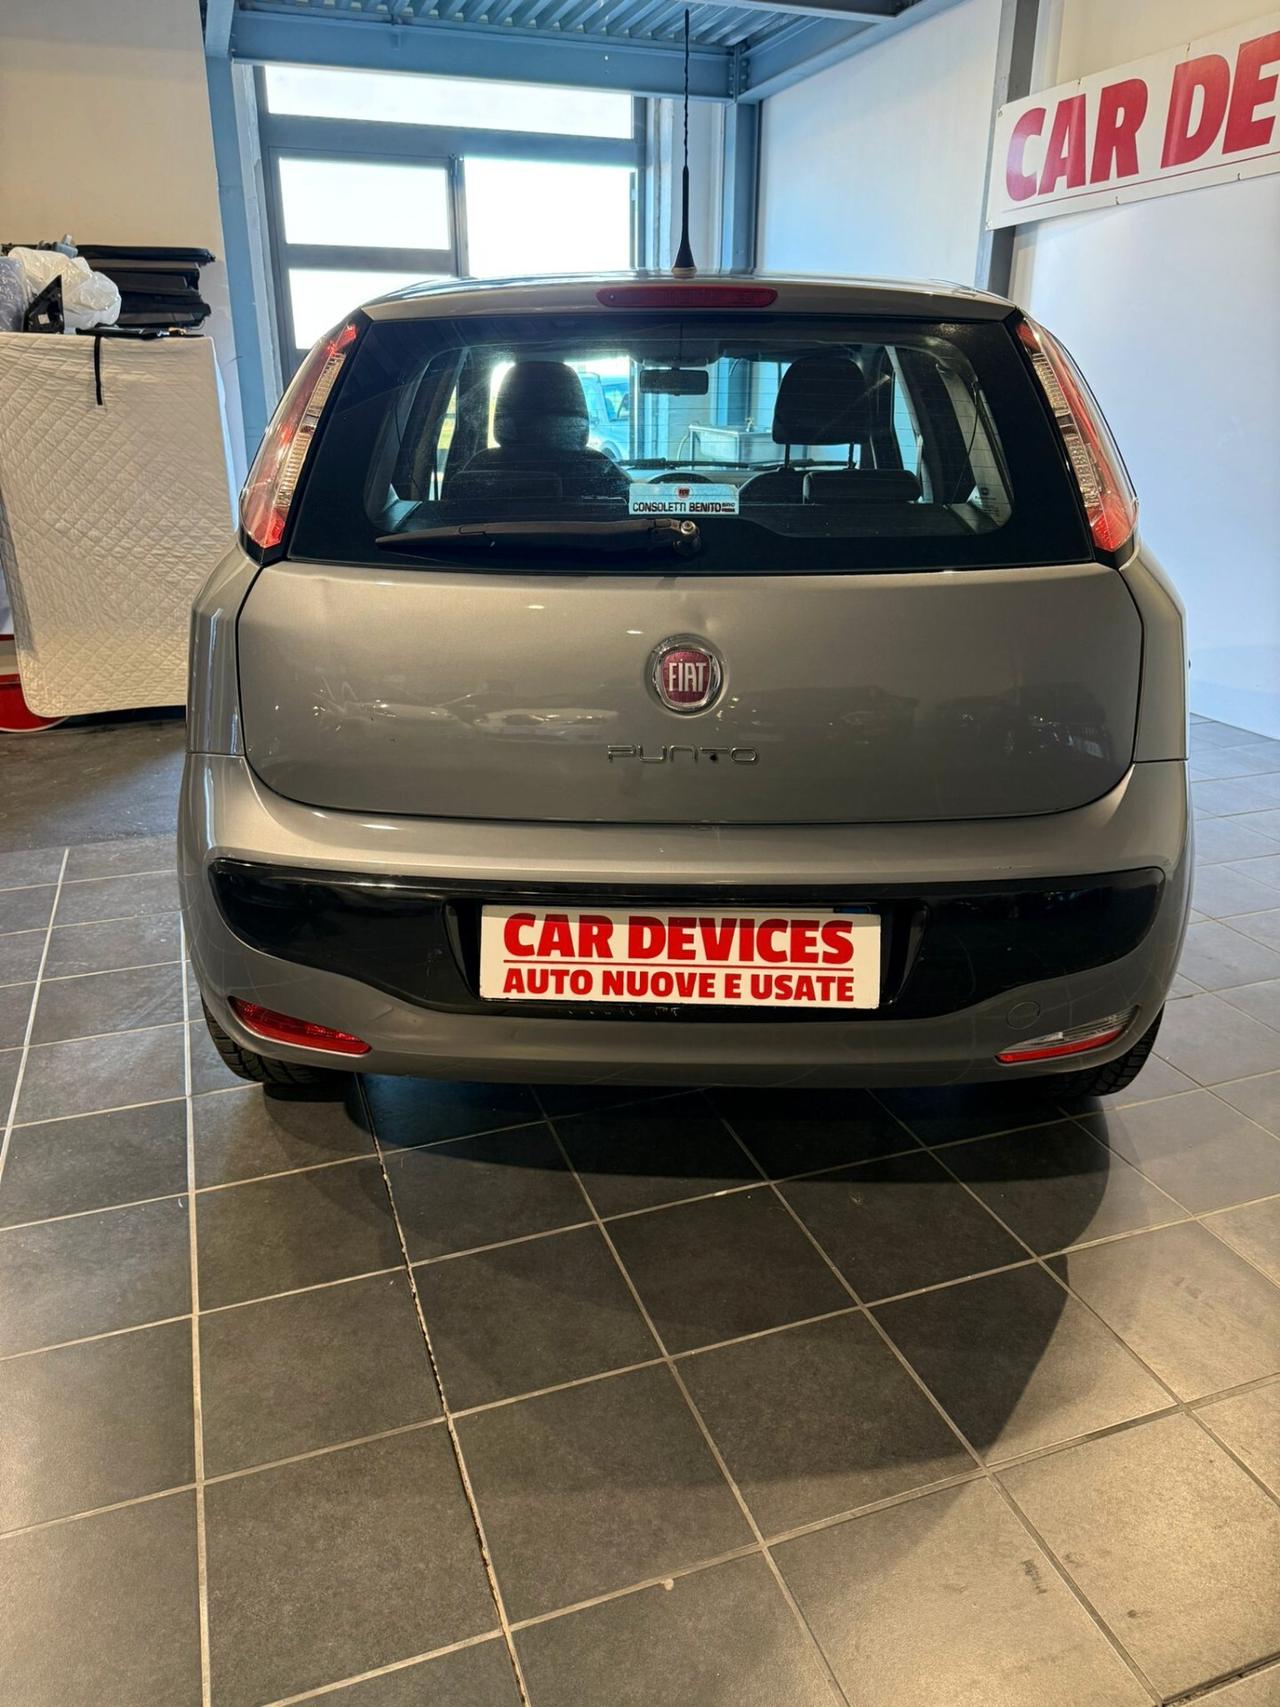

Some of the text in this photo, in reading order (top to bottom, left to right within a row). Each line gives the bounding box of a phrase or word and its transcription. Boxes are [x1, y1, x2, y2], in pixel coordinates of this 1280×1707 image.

[1005, 78, 1149, 202] CAR
[632, 501, 686, 512] CONSOLETTI
[689, 501, 722, 512] BENITO
[668, 662, 707, 692] FIAT
[503, 912, 854, 965] CAR DEVICES
[503, 968, 854, 1002] AUTO NUOVE E USATE
